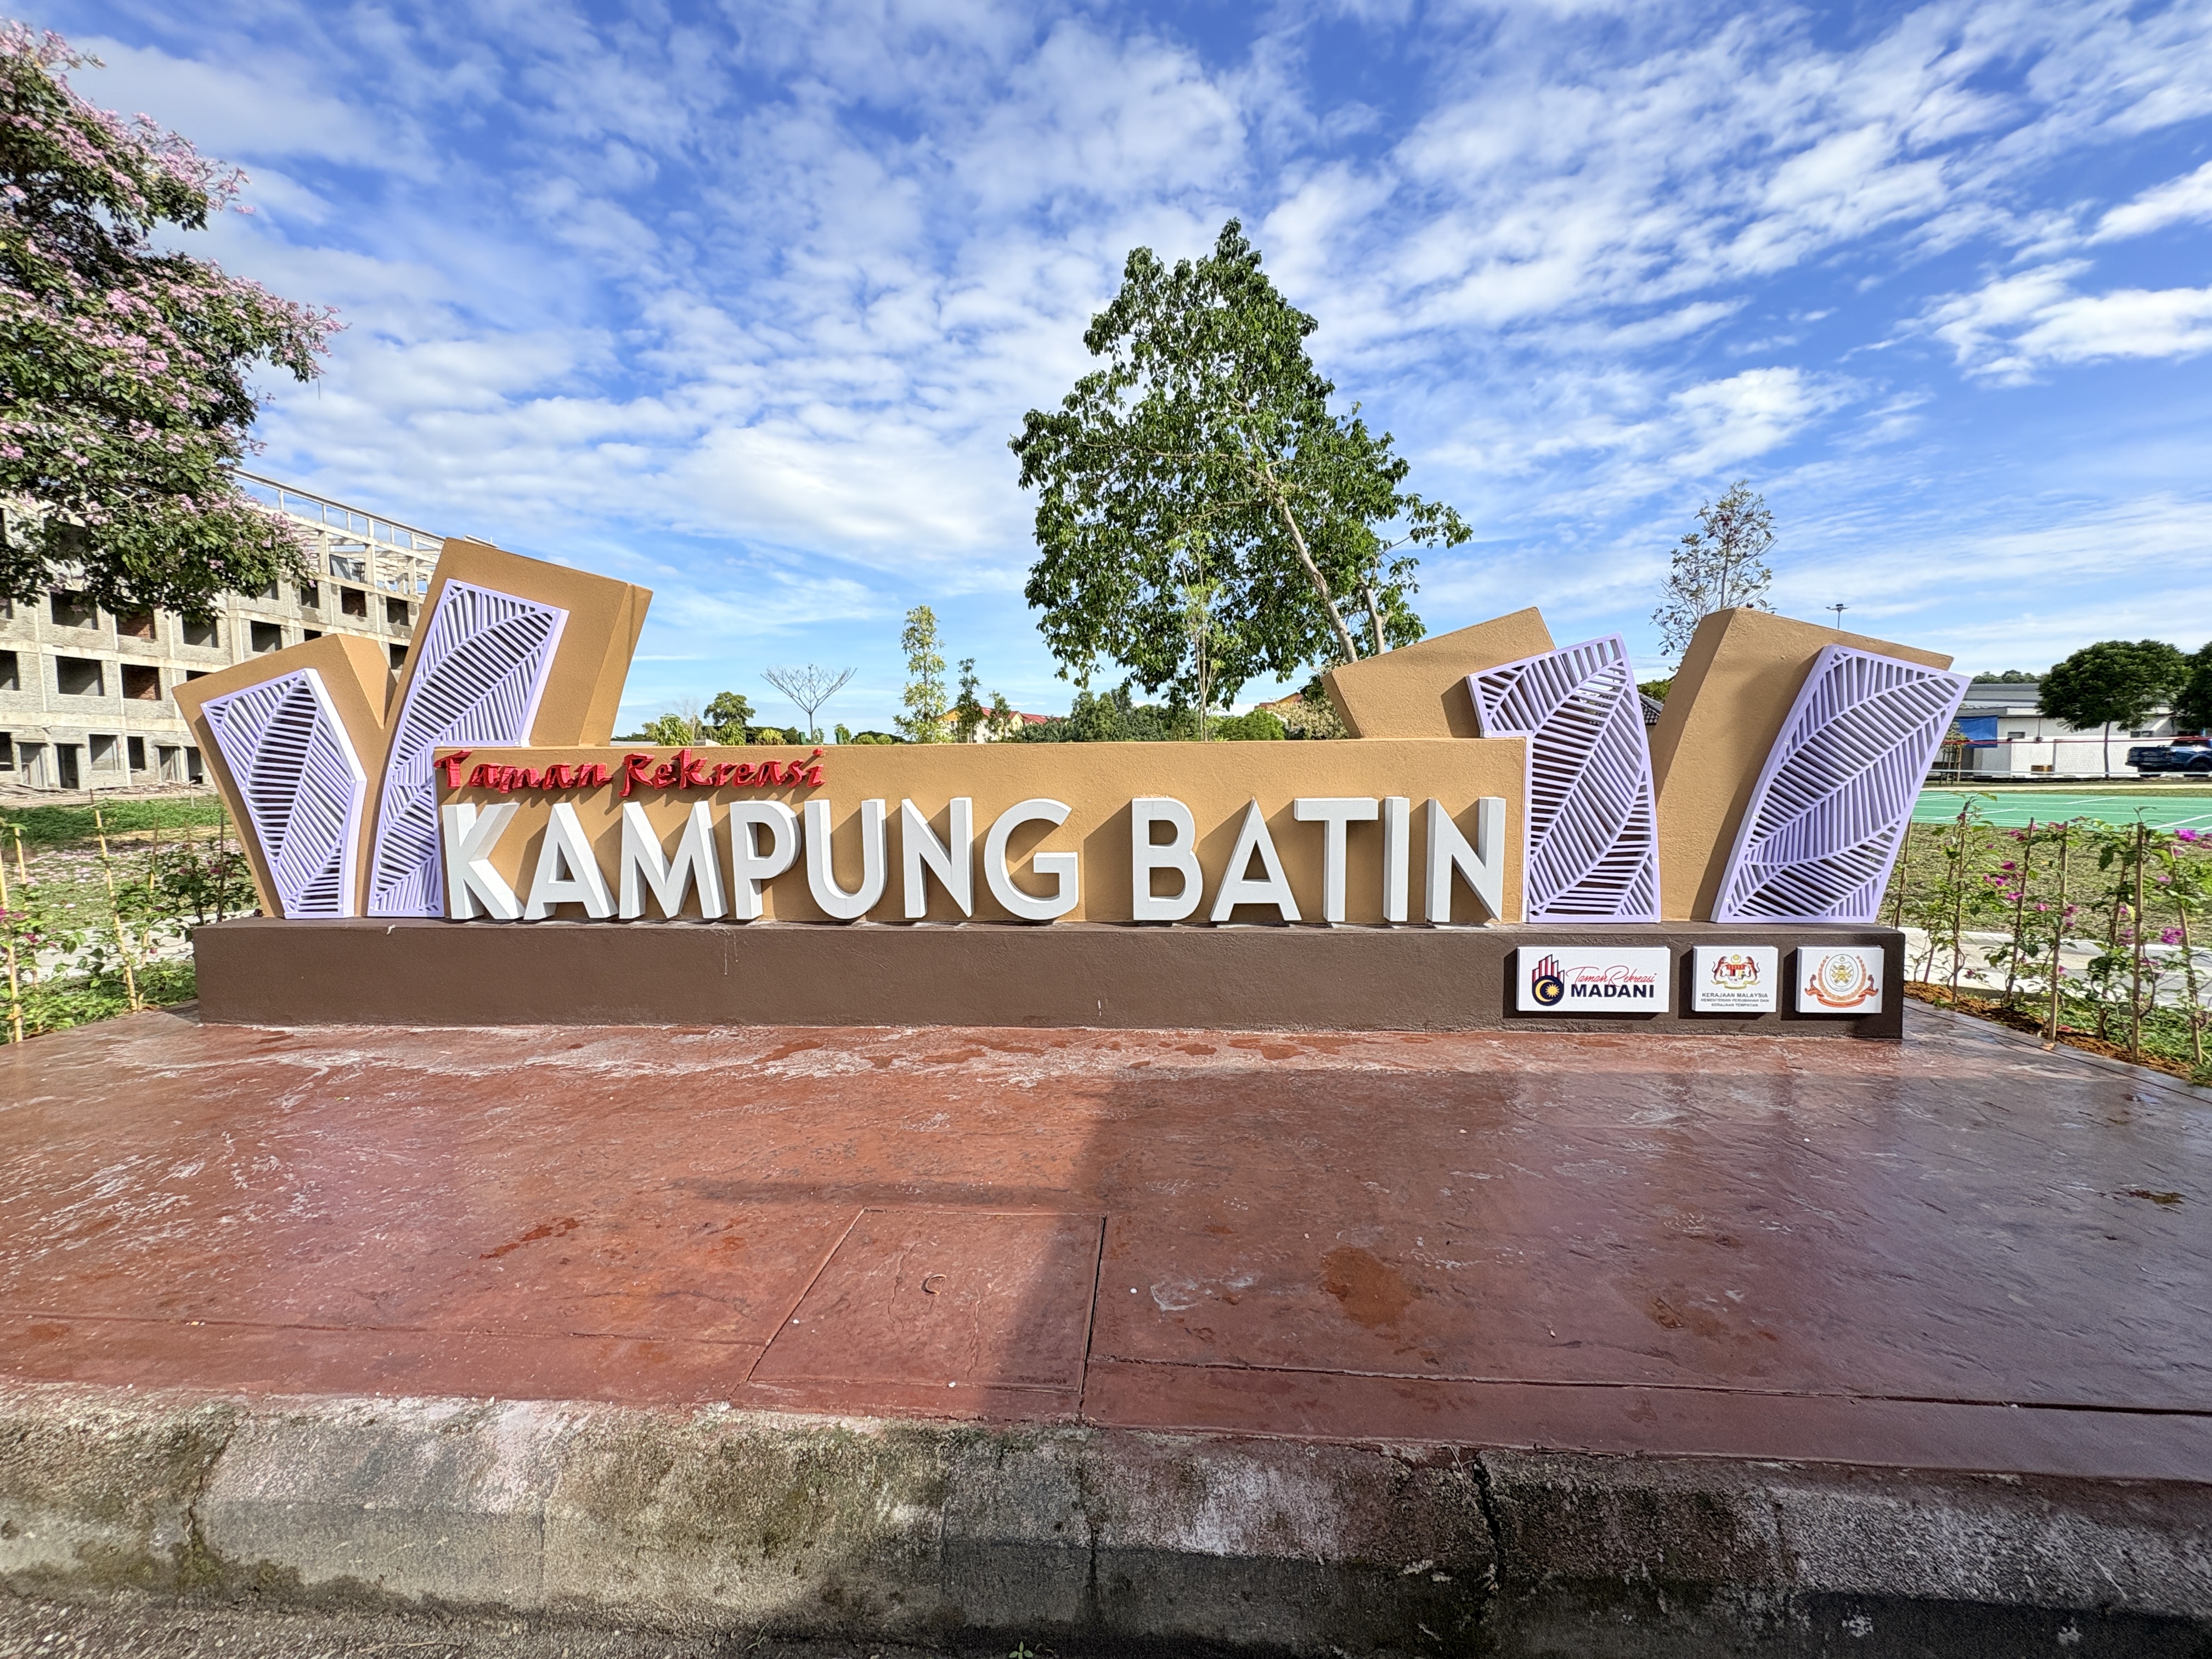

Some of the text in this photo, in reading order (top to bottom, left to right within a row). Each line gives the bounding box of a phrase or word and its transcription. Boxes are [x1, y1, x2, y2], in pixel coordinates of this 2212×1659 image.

[434, 748, 826, 797] Taman Rekreasi
[442, 797, 1506, 922] KAMPUNG BATIN
[1566, 965, 1657, 988] Taman Rekreasi
[1571, 984, 1654, 998] MADANI
